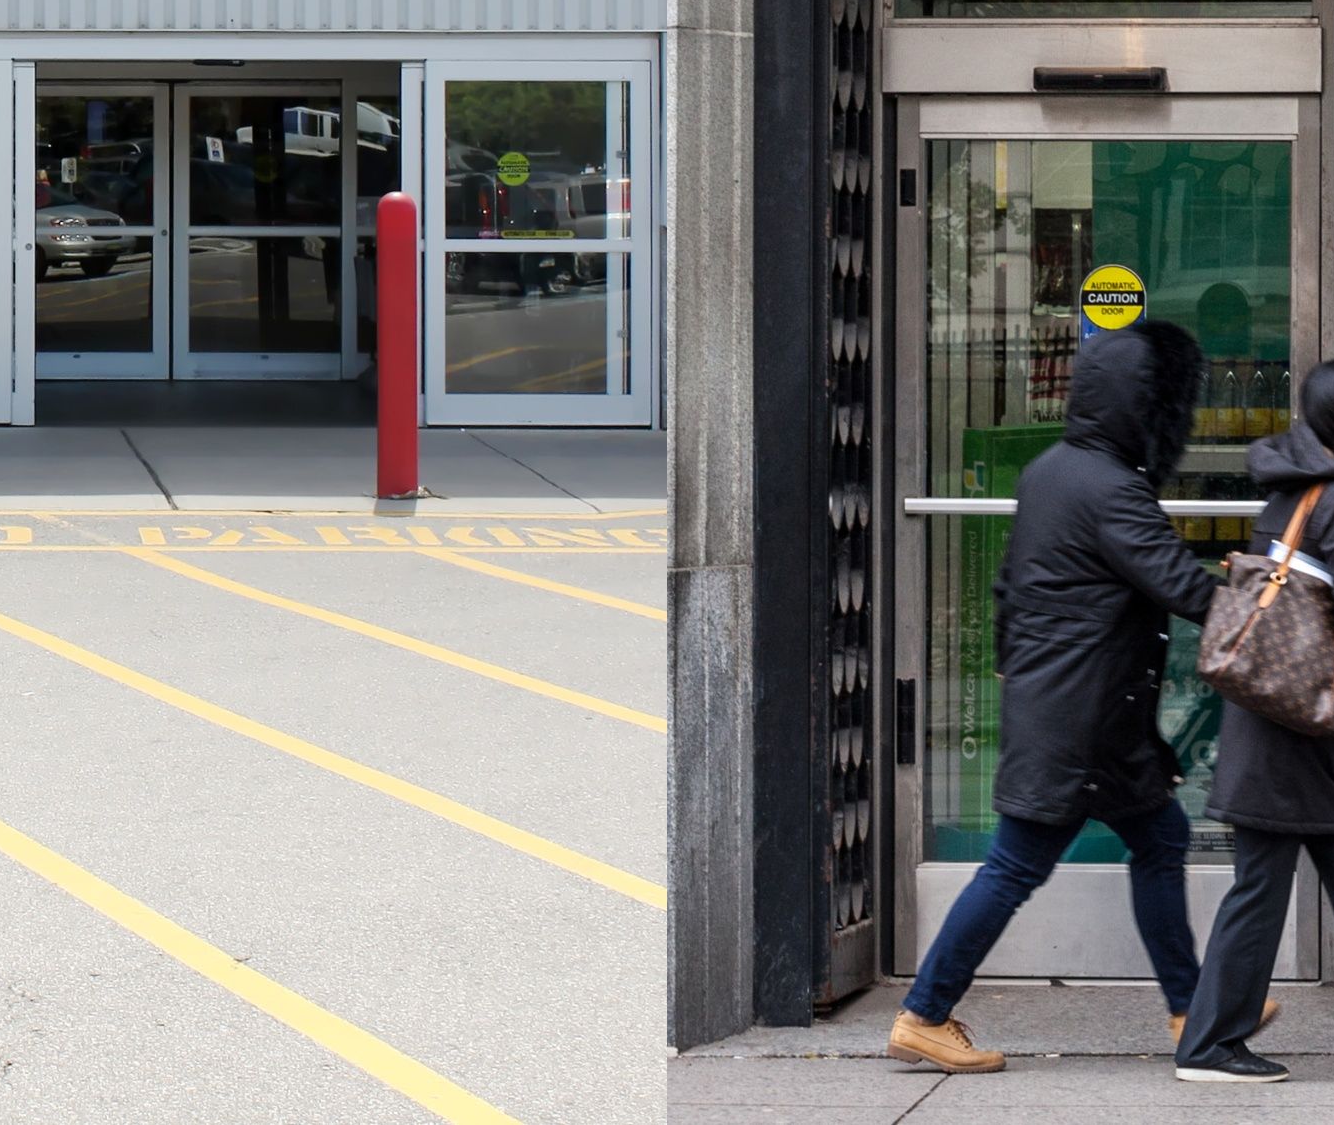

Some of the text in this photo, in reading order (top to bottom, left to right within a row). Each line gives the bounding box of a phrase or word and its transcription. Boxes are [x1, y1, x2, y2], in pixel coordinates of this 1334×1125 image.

[1091, 282, 1135, 290] AUTOMATIC
[1088, 293, 1138, 304] CAUTION
[1101, 307, 1124, 315] DOOR
